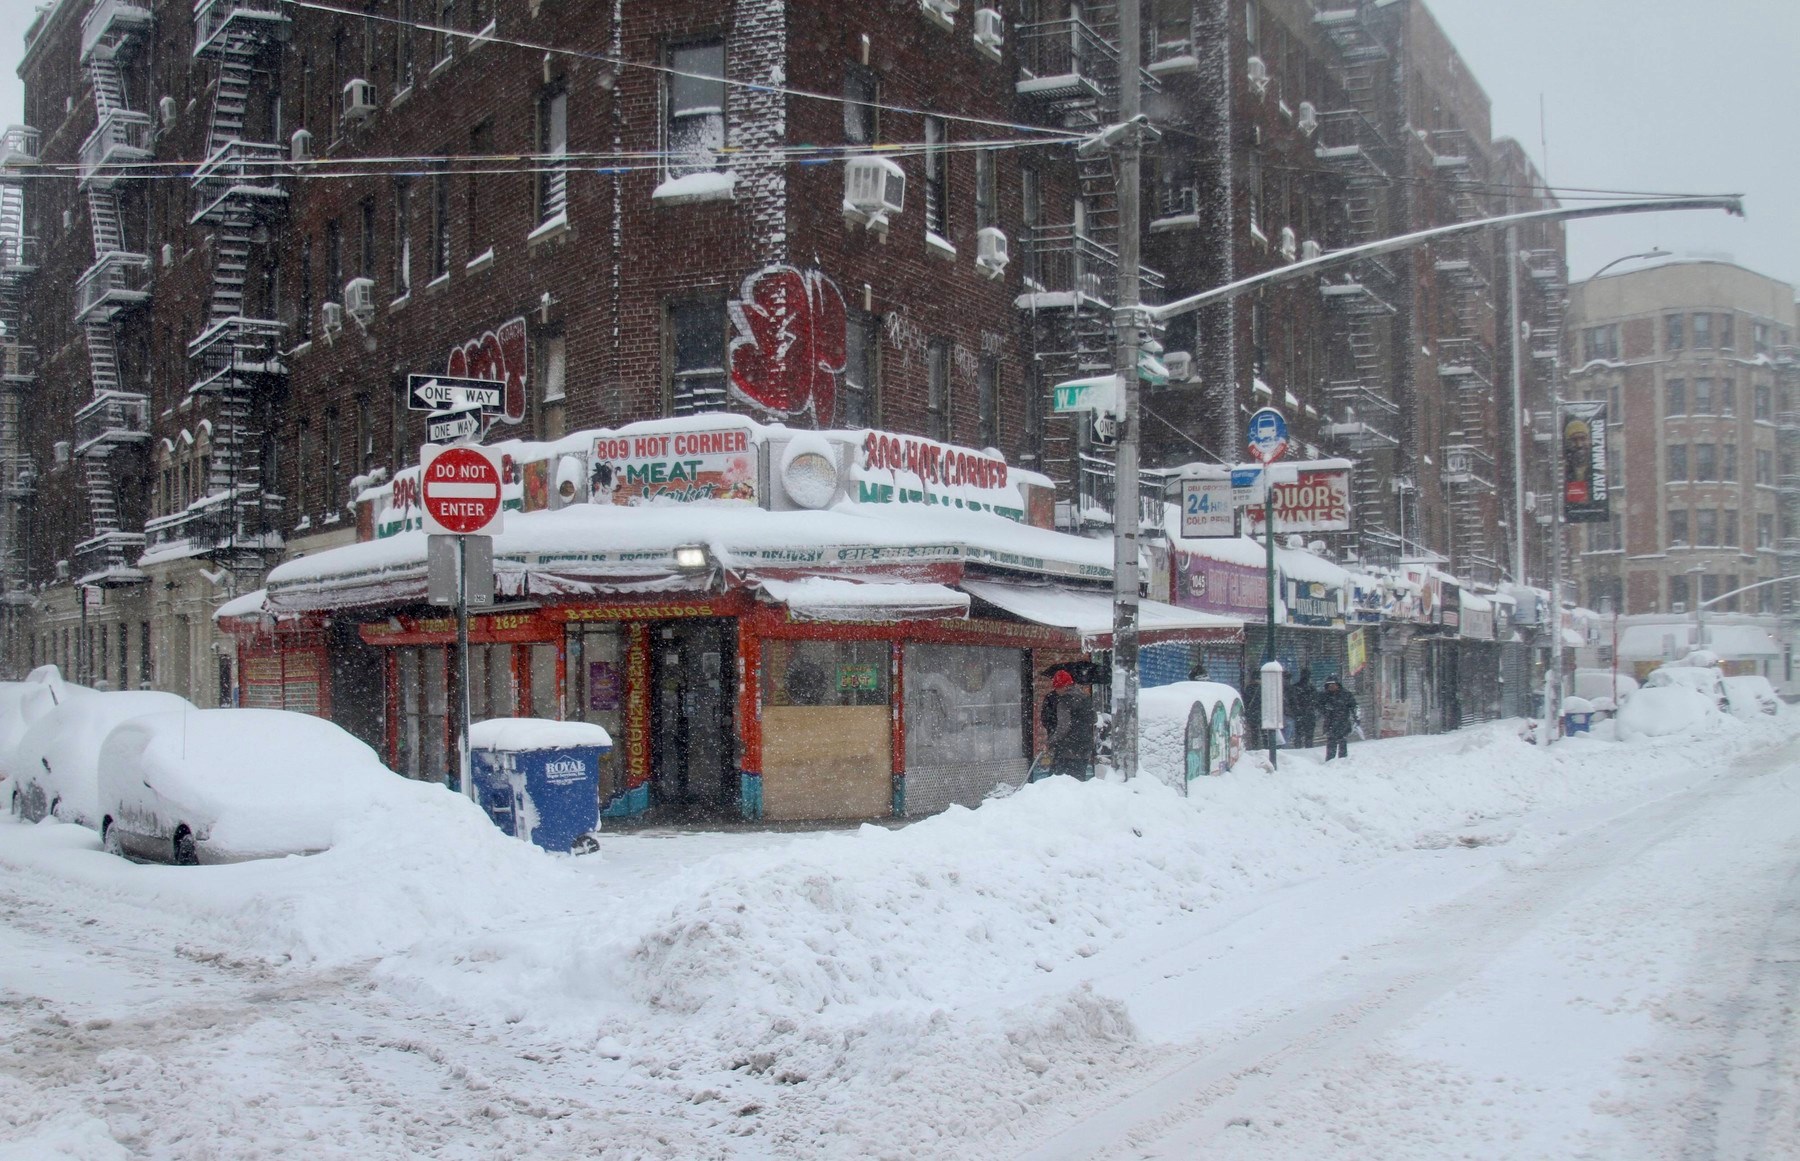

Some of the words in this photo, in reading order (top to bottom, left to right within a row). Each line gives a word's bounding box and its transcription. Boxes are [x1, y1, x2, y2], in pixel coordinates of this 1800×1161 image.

[425, 386, 452, 401] ONE
[465, 389, 494, 404] WAY
[1057, 389, 1070, 408] W
[434, 422, 451, 439] ONE
[457, 420, 474, 434] WAY
[1100, 419, 1114, 435] ONE
[597, 439, 630, 460] 809
[635, 436, 671, 458] HOT
[674, 431, 748, 455] CORNER
[1591, 419, 1606, 471] AMAZING
[436, 465, 455, 478] DO
[460, 465, 487, 479] NOT
[627, 460, 703, 485] MEAT
[905, 440, 941, 485] HOT
[944, 449, 1008, 489] CORNER
[1592, 472, 1607, 501] STAY
[440, 503, 485, 517] ENTER
[1187, 493, 1210, 515] 24
[1186, 516, 1207, 526] COLD
[1191, 575, 1205, 588] 1045
[564, 605, 714, 620] BIENVENIDOS
[496, 615, 517, 630] 162
[1005, 624, 1052, 641] HEIGHTS
[629, 621, 644, 776] BIENVENIDOS
[545, 760, 587, 773] ROYAL
